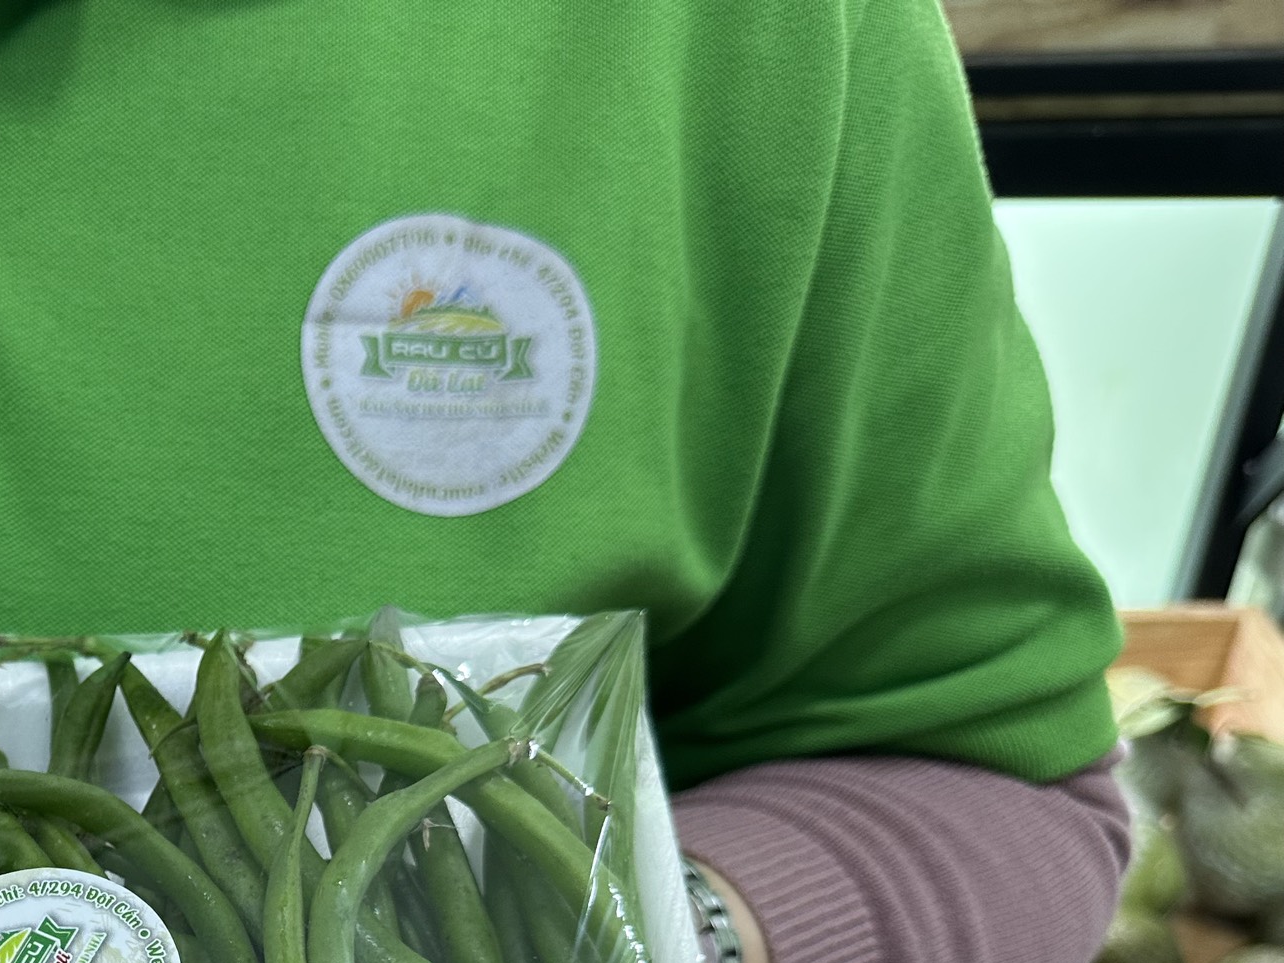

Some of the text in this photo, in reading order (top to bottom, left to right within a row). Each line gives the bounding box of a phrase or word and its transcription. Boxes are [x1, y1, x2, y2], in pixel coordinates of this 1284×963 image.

[391, 342, 447, 359] RAU
[29, 881, 82, 898] 4/294
[86, 887, 115, 907] Đội
[114, 902, 141, 929] Cấn
